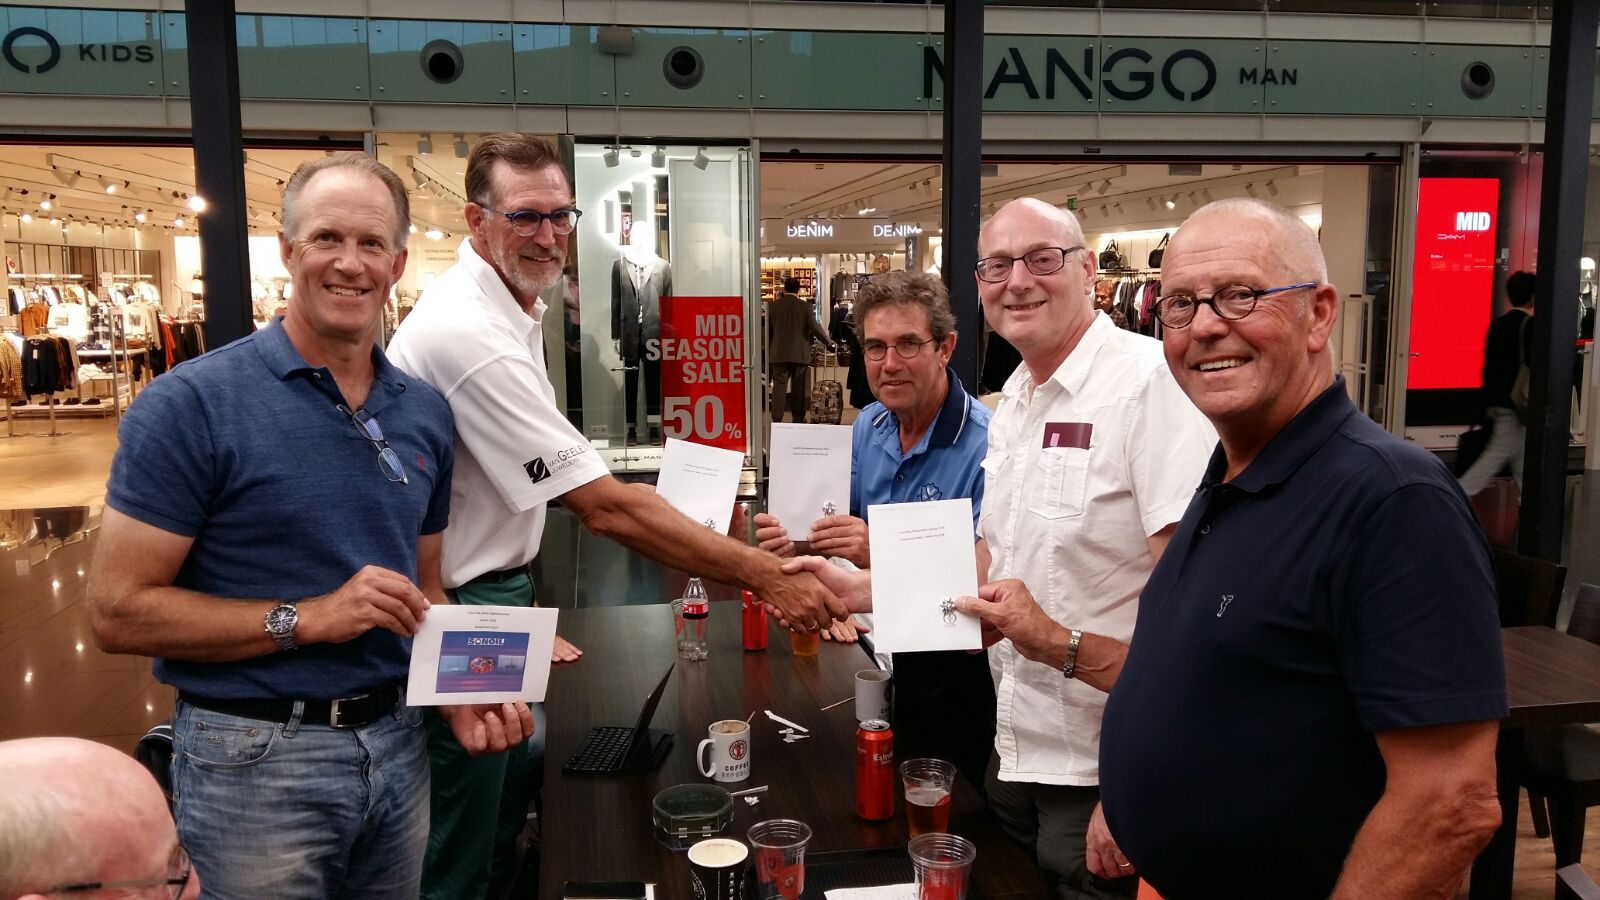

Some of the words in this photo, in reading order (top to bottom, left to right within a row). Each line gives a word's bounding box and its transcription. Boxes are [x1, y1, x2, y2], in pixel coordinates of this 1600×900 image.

[79, 44, 154, 63] KIDS
[1239, 67, 1298, 86] MAN
[787, 225, 833, 237] DENIM
[873, 225, 918, 237] DENIM
[1456, 212, 1491, 231] MID
[695, 314, 741, 337] MID
[645, 337, 741, 362] SEASON
[682, 361, 742, 384] SALE
